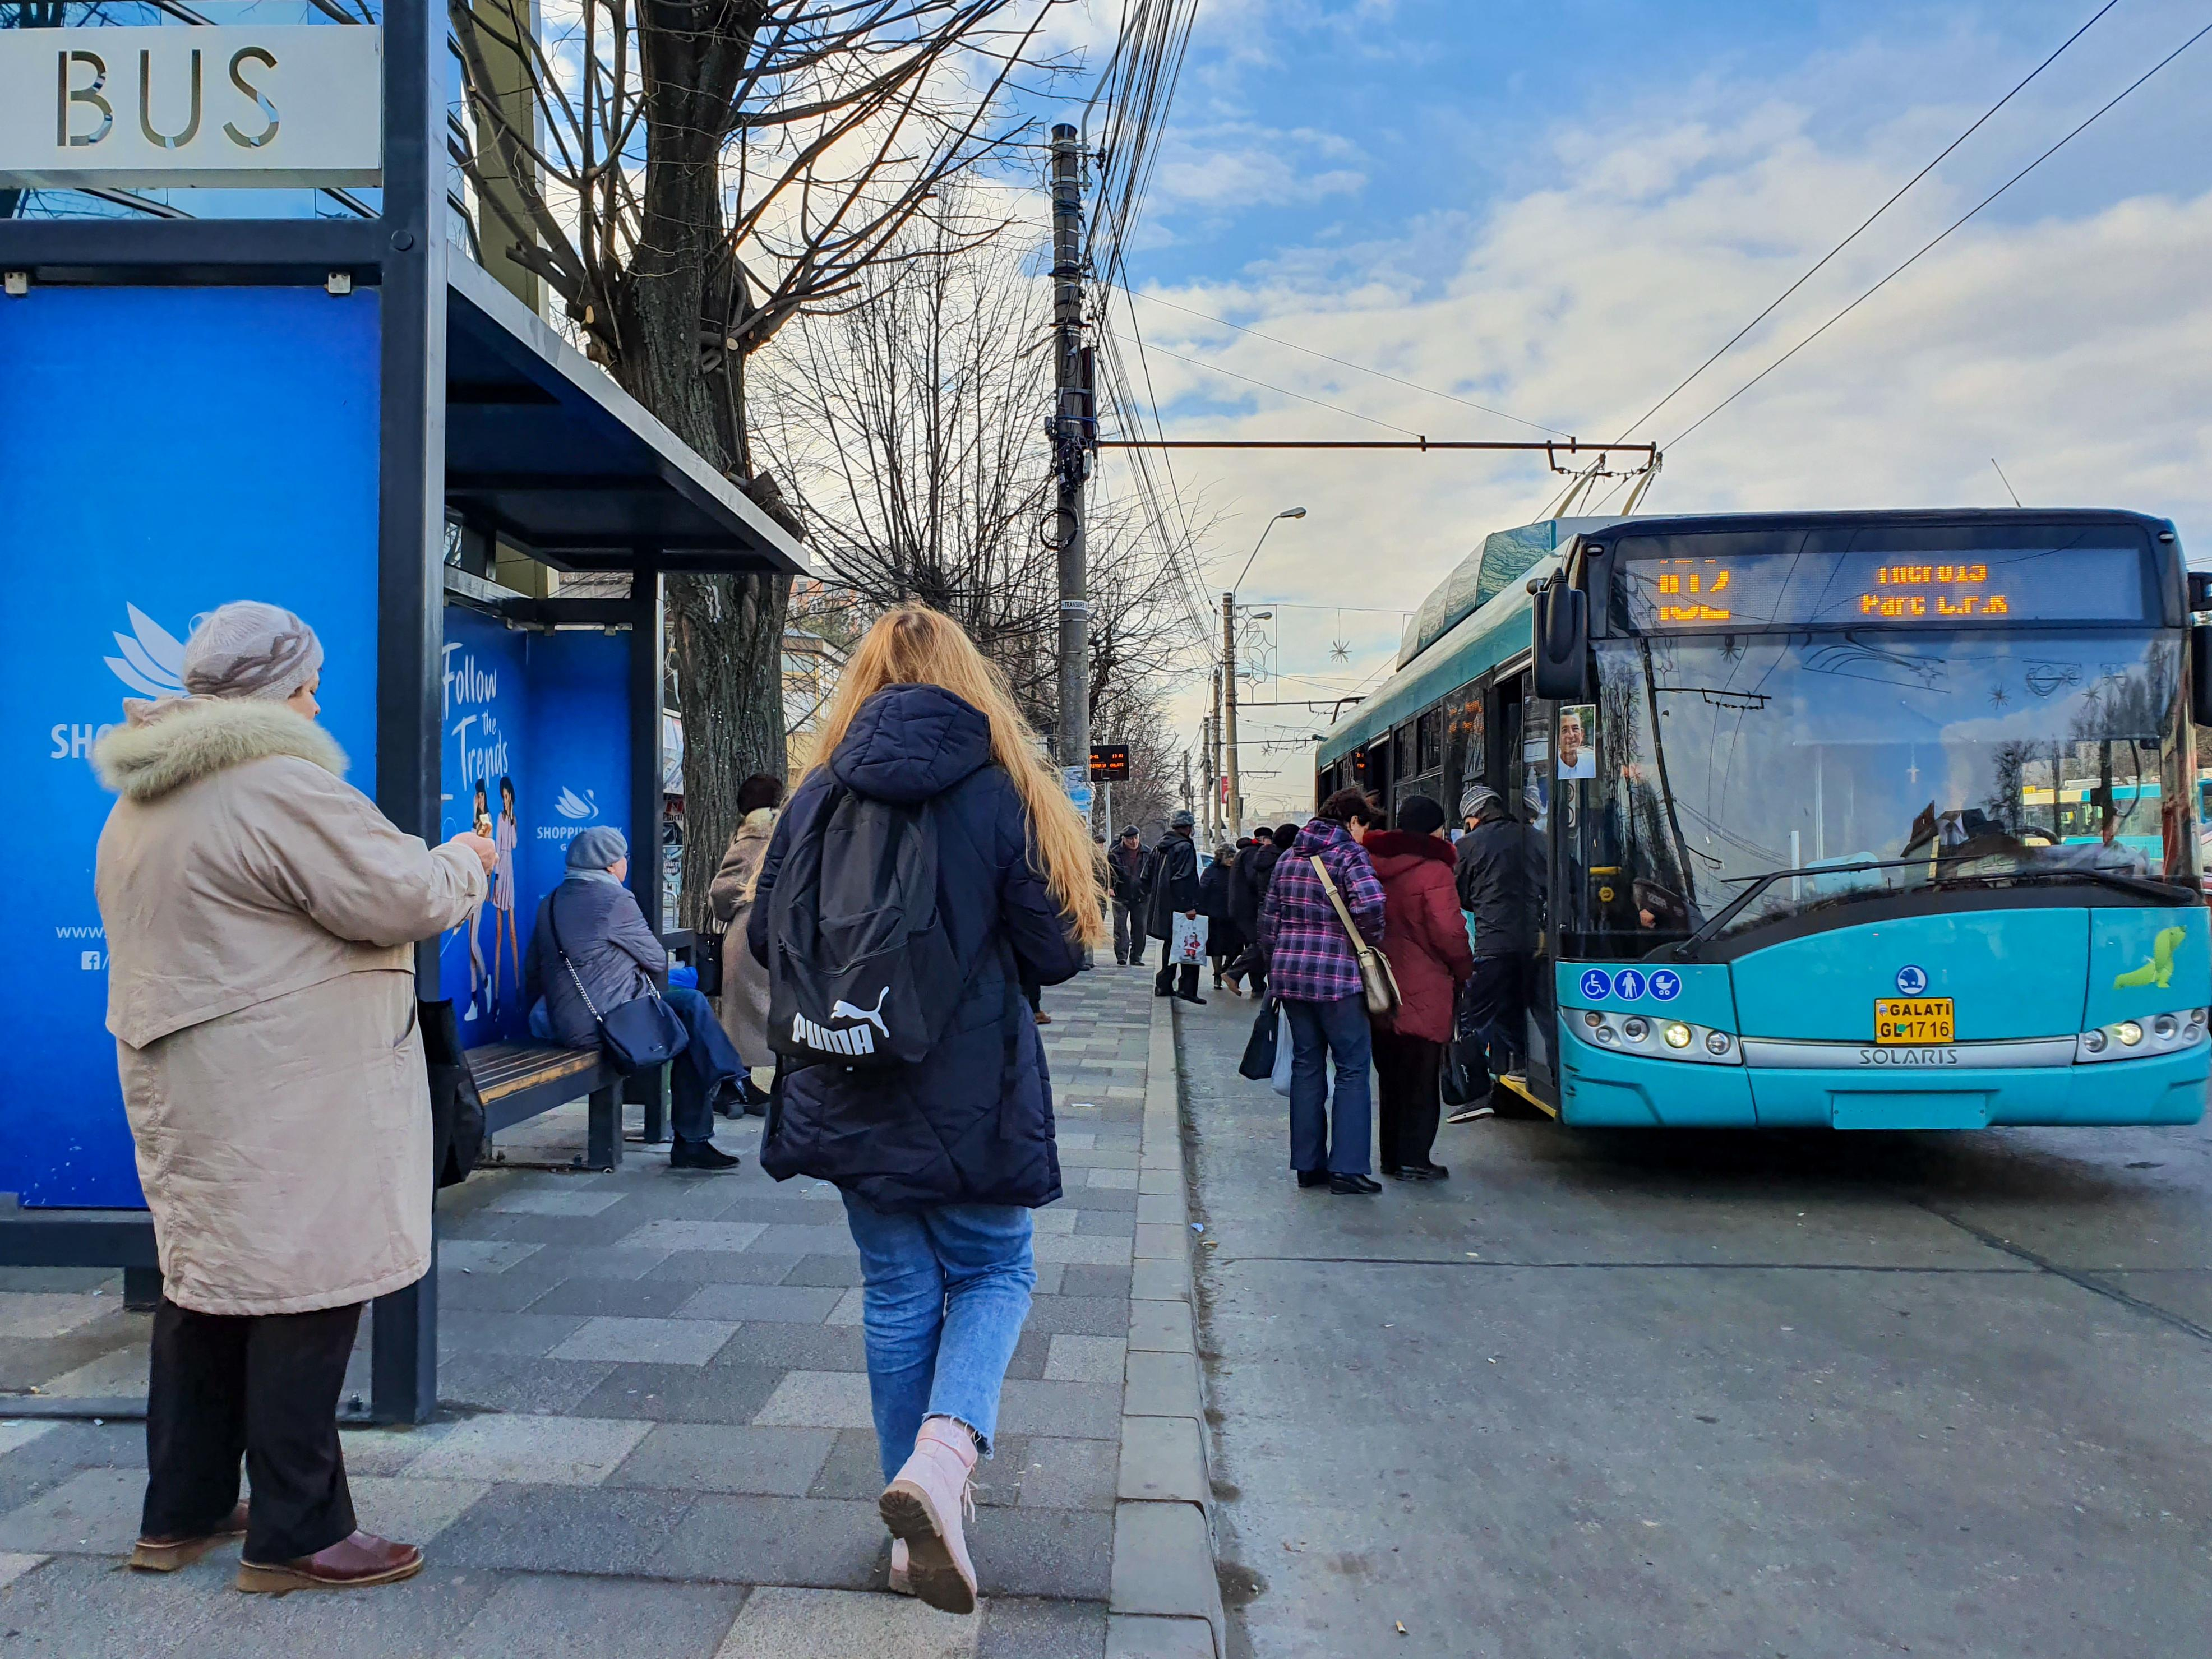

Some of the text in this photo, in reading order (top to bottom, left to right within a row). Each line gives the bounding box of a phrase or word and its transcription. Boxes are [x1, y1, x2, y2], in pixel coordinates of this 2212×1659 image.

[57, 46, 280, 149] BUS
[442, 642, 497, 720] Follow
[481, 709, 497, 736] the
[451, 714, 509, 792] Trends
[1890, 1003, 1951, 1016] GALATI
[791, 1011, 875, 1056] PUMA
[1859, 1048, 1959, 1065] SOLARIS
